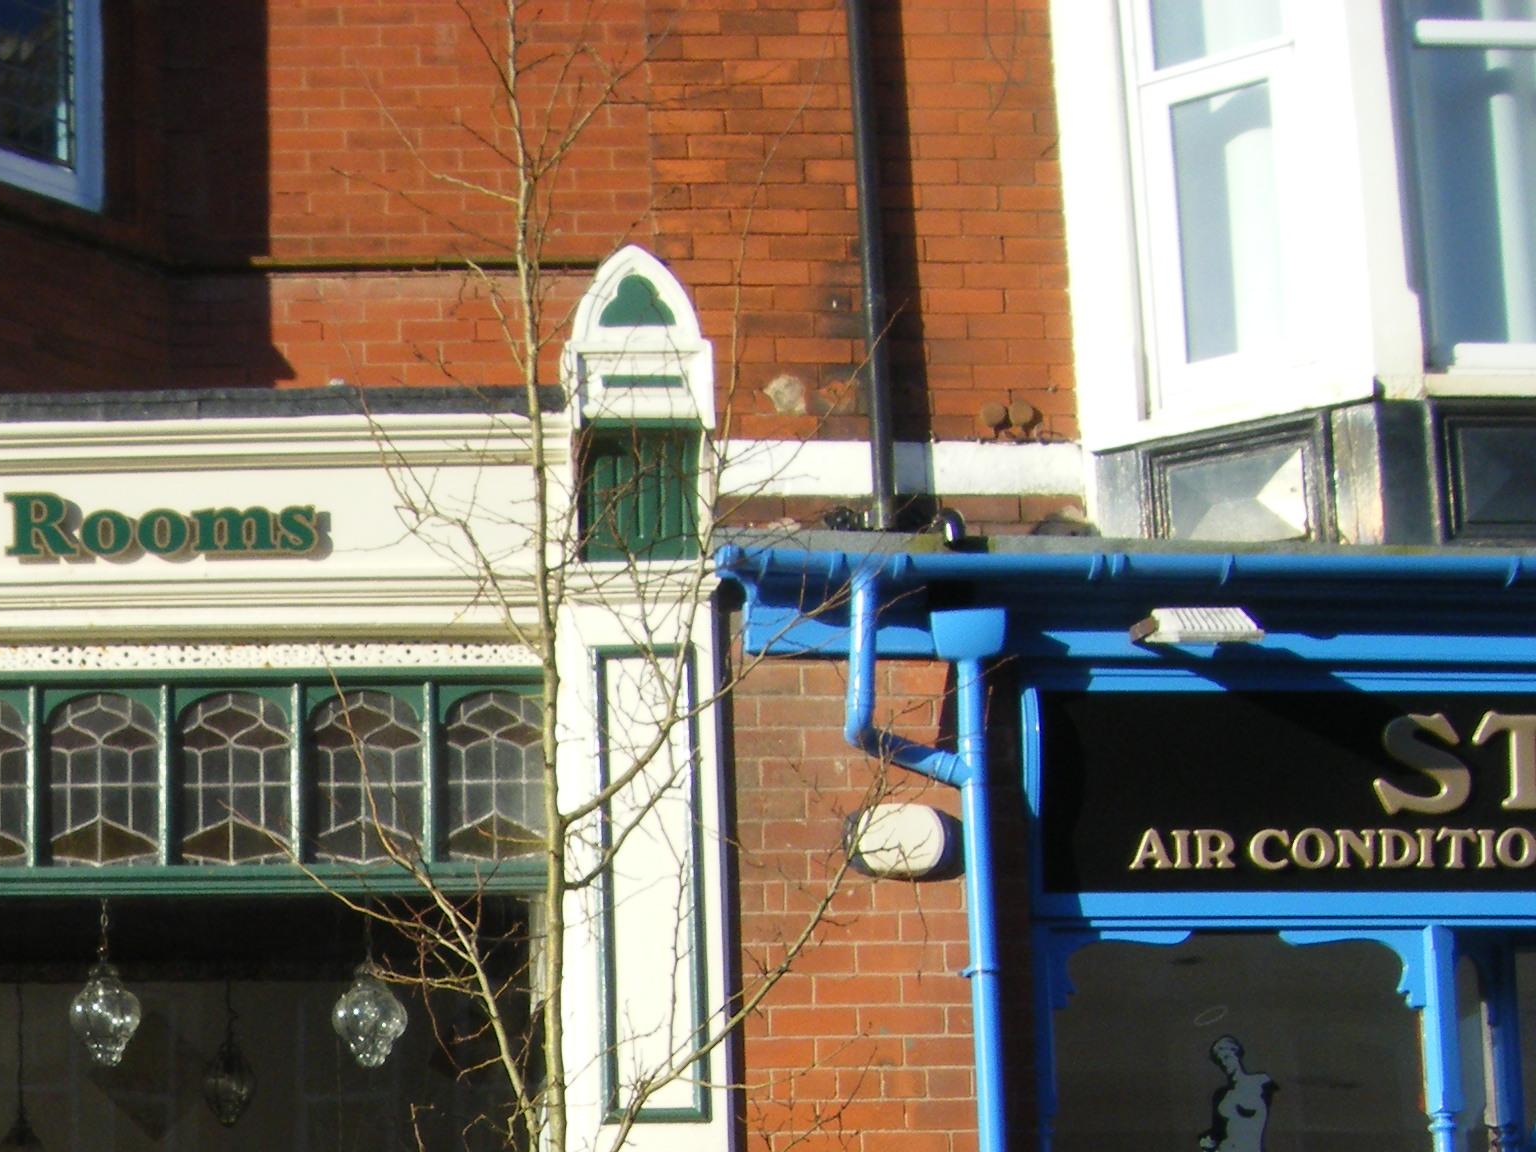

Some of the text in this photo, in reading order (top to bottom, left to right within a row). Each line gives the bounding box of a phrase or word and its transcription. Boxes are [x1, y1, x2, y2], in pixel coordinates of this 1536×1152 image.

[4, 491, 319, 557] Rooms
[1372, 710, 1536, 815] ST
[1128, 828, 1536, 870] AIR CONDITIO
